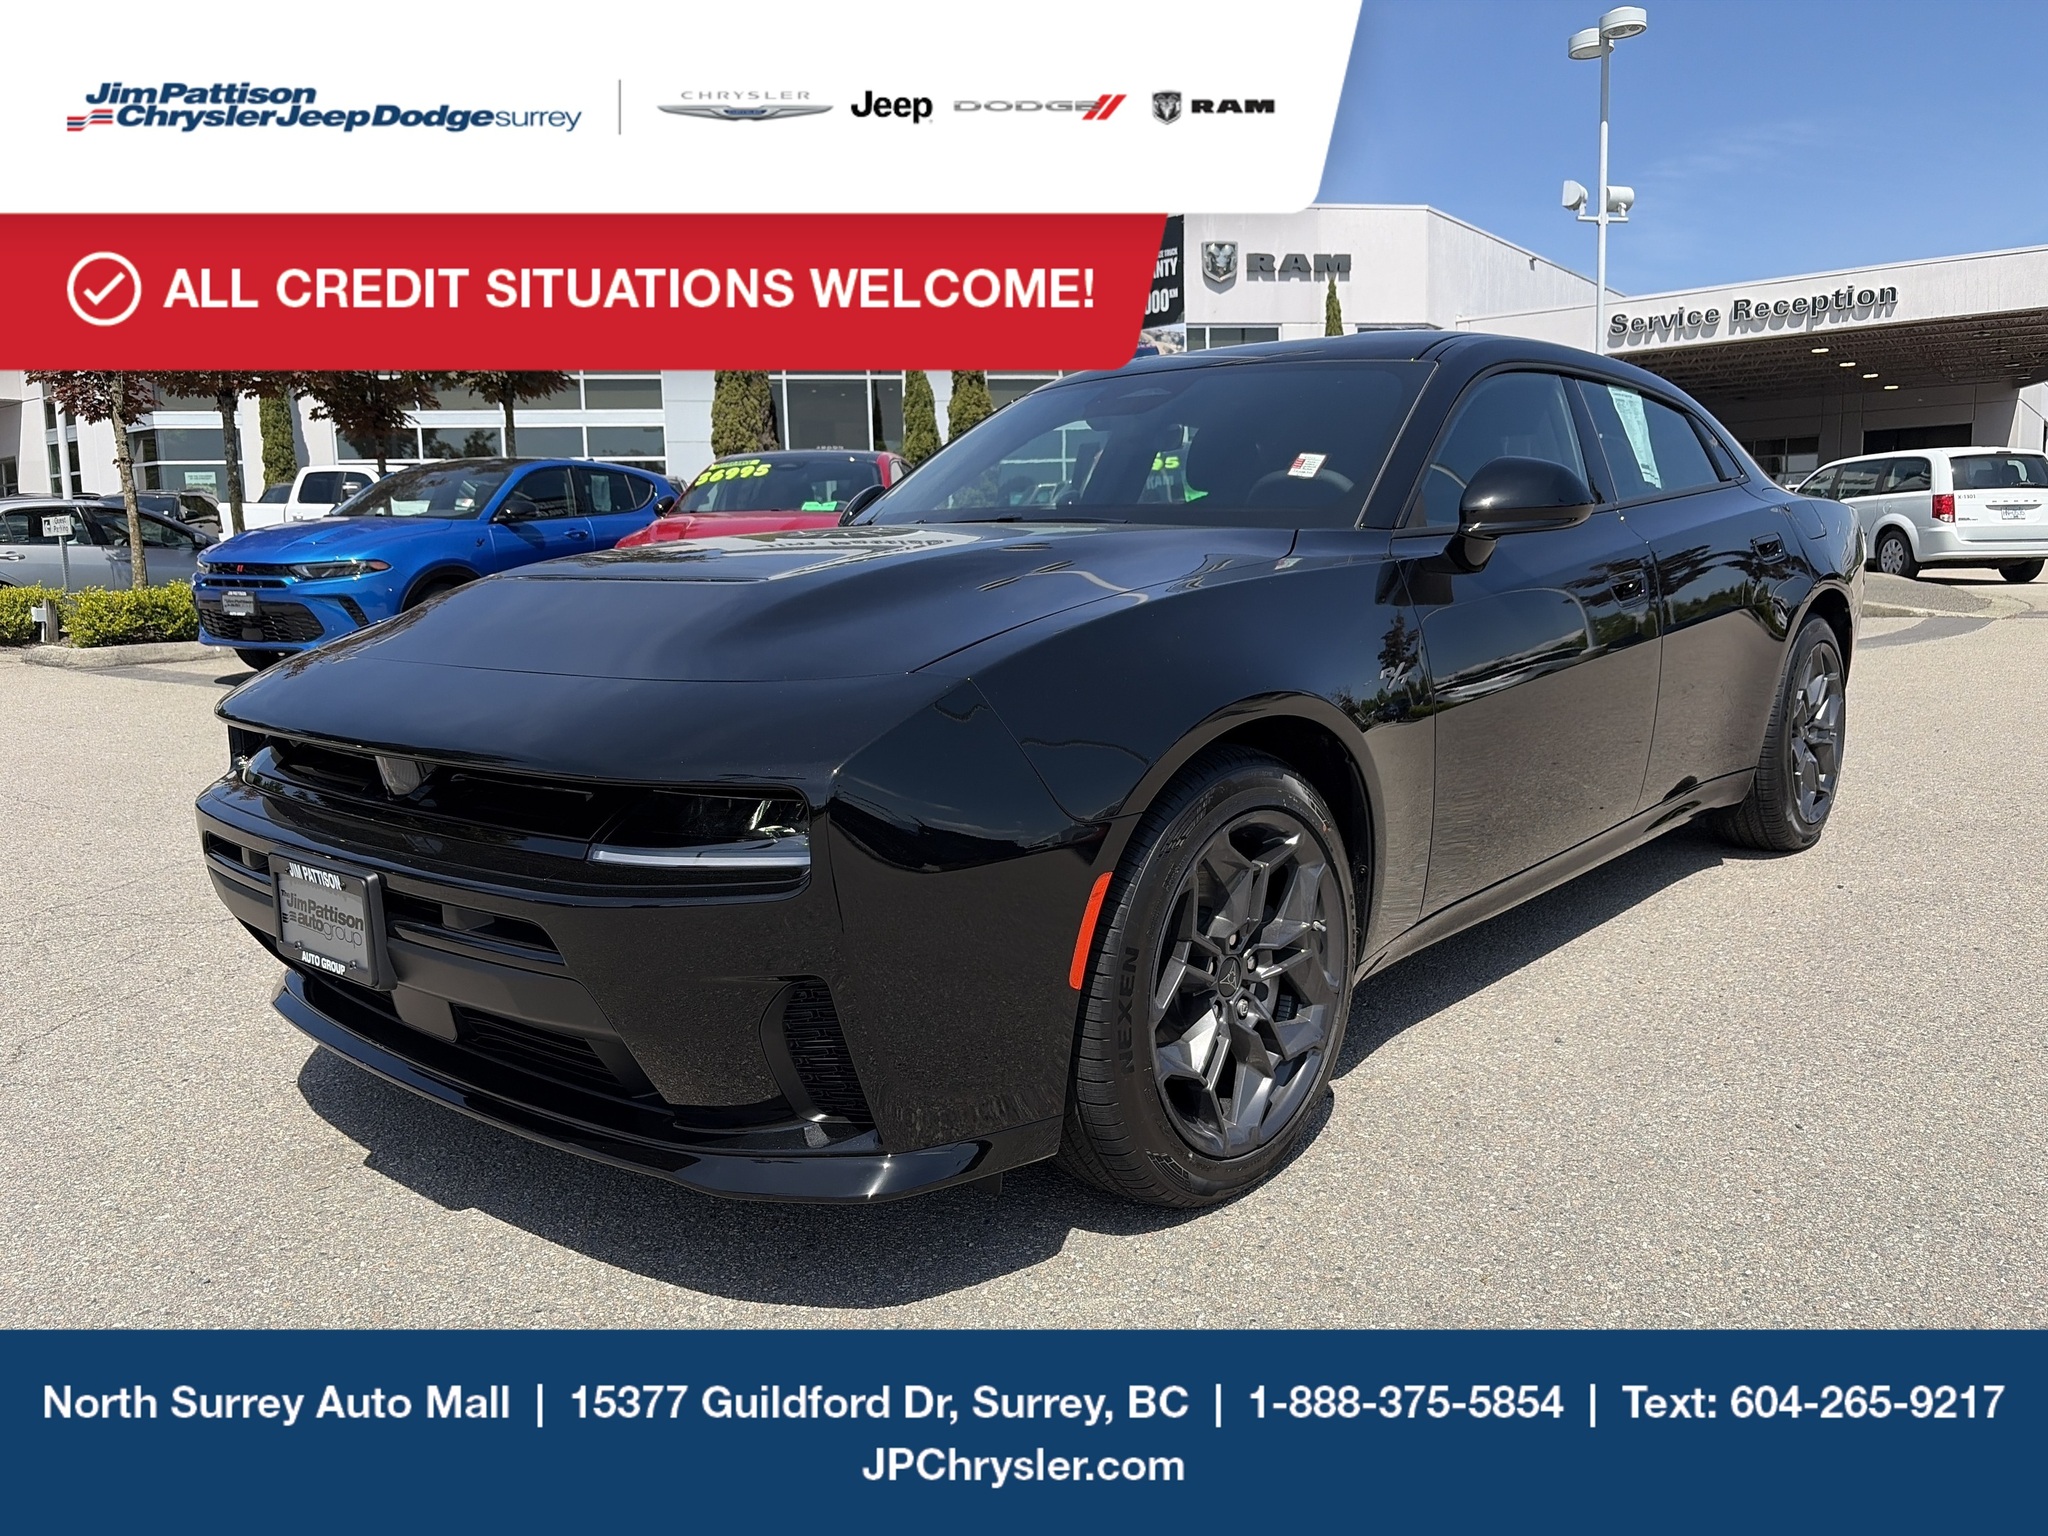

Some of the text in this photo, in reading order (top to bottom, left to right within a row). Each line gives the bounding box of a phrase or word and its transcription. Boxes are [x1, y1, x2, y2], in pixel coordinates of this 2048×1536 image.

[1246, 253, 1352, 272] RAM
[1610, 285, 1899, 335] Service Reception
[289, 862, 342, 891] JIM PATTISON
[302, 951, 346, 975] AUTO GROUP
[1118, 947, 1139, 1074] NEXEN
